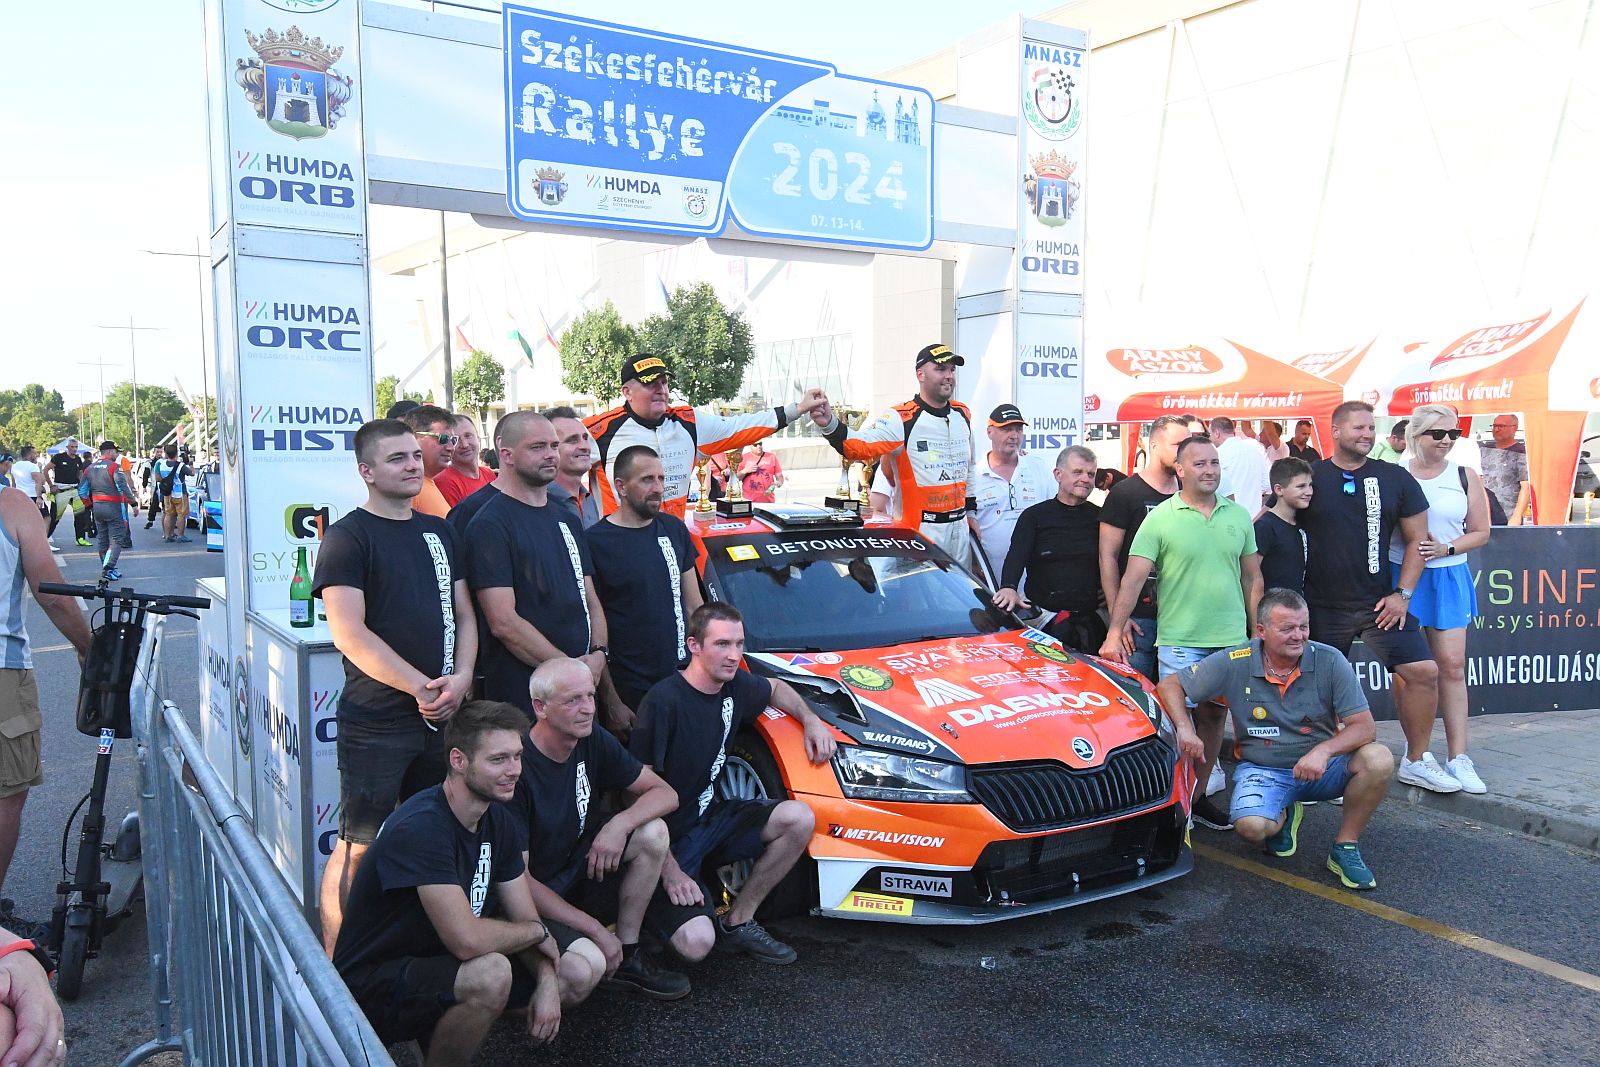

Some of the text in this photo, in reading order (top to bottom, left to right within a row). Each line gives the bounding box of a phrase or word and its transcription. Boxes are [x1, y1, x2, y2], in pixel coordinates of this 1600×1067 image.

[520, 29, 777, 103] Székesfehérvár
[1024, 44, 1081, 68] MNASZ
[519, 82, 706, 161] Rallye
[266, 154, 354, 181] HUMDA
[773, 142, 908, 210] 2024
[239, 176, 355, 208] ORB
[604, 176, 661, 196] HUMDA
[683, 186, 709, 195] MNASZ
[811, 214, 865, 232] 07. 13-14.
[1036, 240, 1079, 256] HUMDA
[1021, 256, 1079, 276] ORB
[274, 302, 360, 325] HUMDA
[247, 325, 361, 351] ORC
[1034, 345, 1078, 360] HUMDA
[1122, 349, 1201, 361] ARANY
[1020, 361, 1078, 378] ORC
[1467, 378, 1514, 400] várunk!
[1243, 392, 1303, 408] várunk!
[278, 405, 365, 425] HUMDA
[1033, 417, 1077, 431] HUMDA
[252, 429, 357, 451] HIST
[1021, 434, 1077, 450] HIST
[765, 537, 926, 555] BETONÚTÉPÍTŐ
[886, 652, 950, 670] SIVA
[951, 645, 1025, 660] GROUP
[949, 691, 1110, 727] DAEWOO
[263, 699, 301, 766] HUMDA
[1248, 727, 1279, 736] STRAVIA
[844, 828, 945, 848] METALVISION
[884, 876, 948, 893] STRAVIA
[852, 895, 904, 912] PIRELLI
